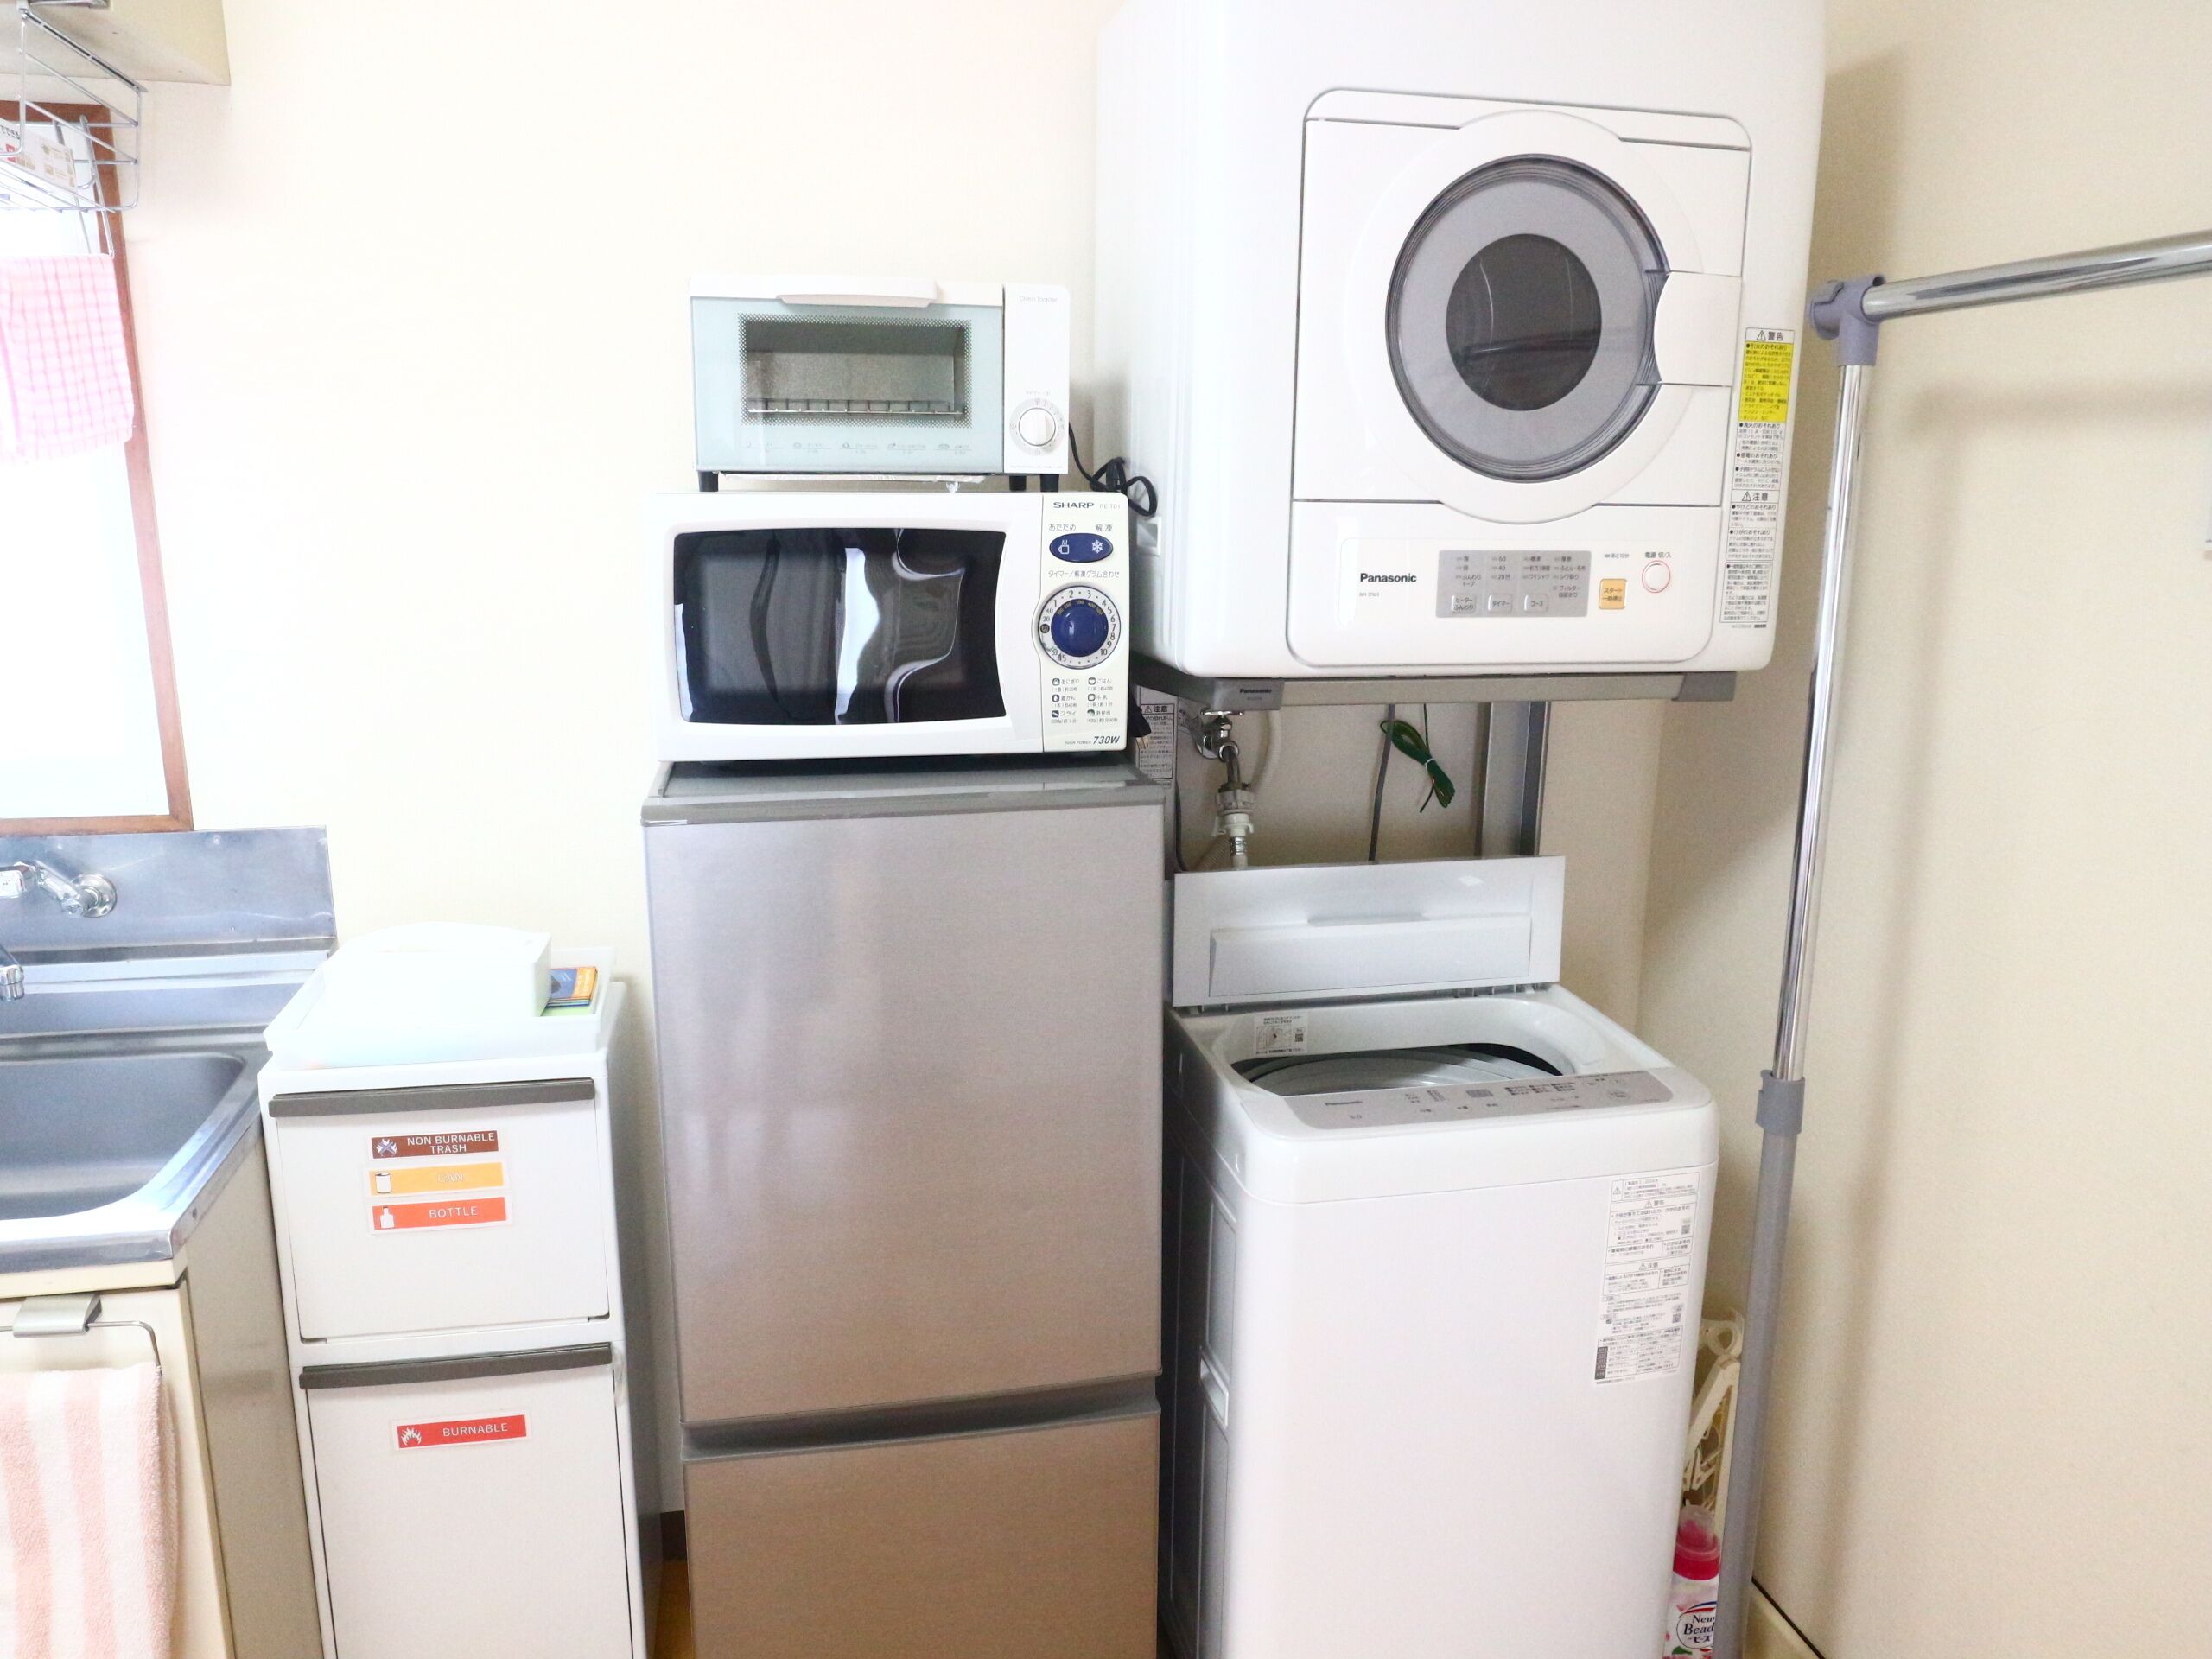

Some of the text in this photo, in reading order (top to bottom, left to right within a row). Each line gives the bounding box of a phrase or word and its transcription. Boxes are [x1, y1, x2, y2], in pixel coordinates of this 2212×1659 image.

[1768, 331, 1784, 341] 警告
[1752, 493, 1769, 502] 注意
[1360, 572, 1417, 582] Panasonic
[1107, 606, 1112, 614] 5
[1109, 632, 1116, 641] 8
[1093, 735, 1120, 745] 730W
[407, 1132, 495, 1146] NON BURNABLE
[429, 1144, 467, 1154] TRASH
[429, 1206, 478, 1219] BOTTLE
[442, 1423, 508, 1437] BURNABLE
[1693, 1614, 1715, 1624] New
